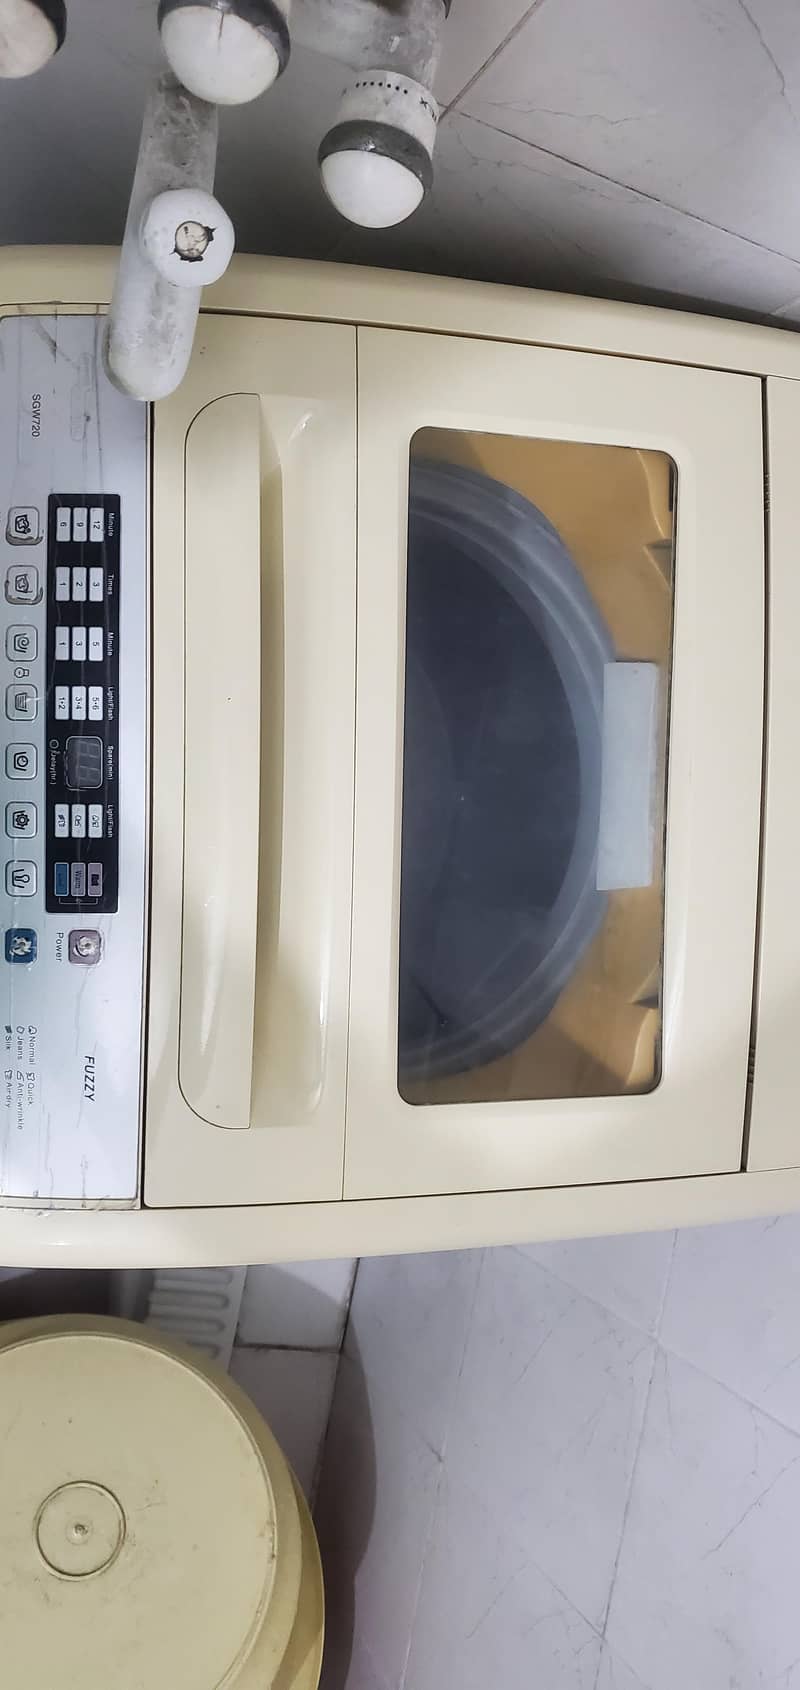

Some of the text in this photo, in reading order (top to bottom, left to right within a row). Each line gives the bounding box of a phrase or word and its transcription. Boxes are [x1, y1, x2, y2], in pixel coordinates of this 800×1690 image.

[32, 394, 41, 437] SGW720
[93, 519, 101, 530] 12
[107, 575, 115, 595] Times
[107, 687, 115, 720] Light/Flash
[107, 746, 115, 780] Spare(min)
[107, 805, 115, 838] Light/Flash
[75, 870, 83, 888] Warm
[56, 933, 64, 962] Power
[17, 1036, 25, 1060] Jeans
[29, 1036, 37, 1064] Normal
[84, 1056, 95, 1101] FUZZY
[17, 1083, 25, 1129] Anti-wrinkle
